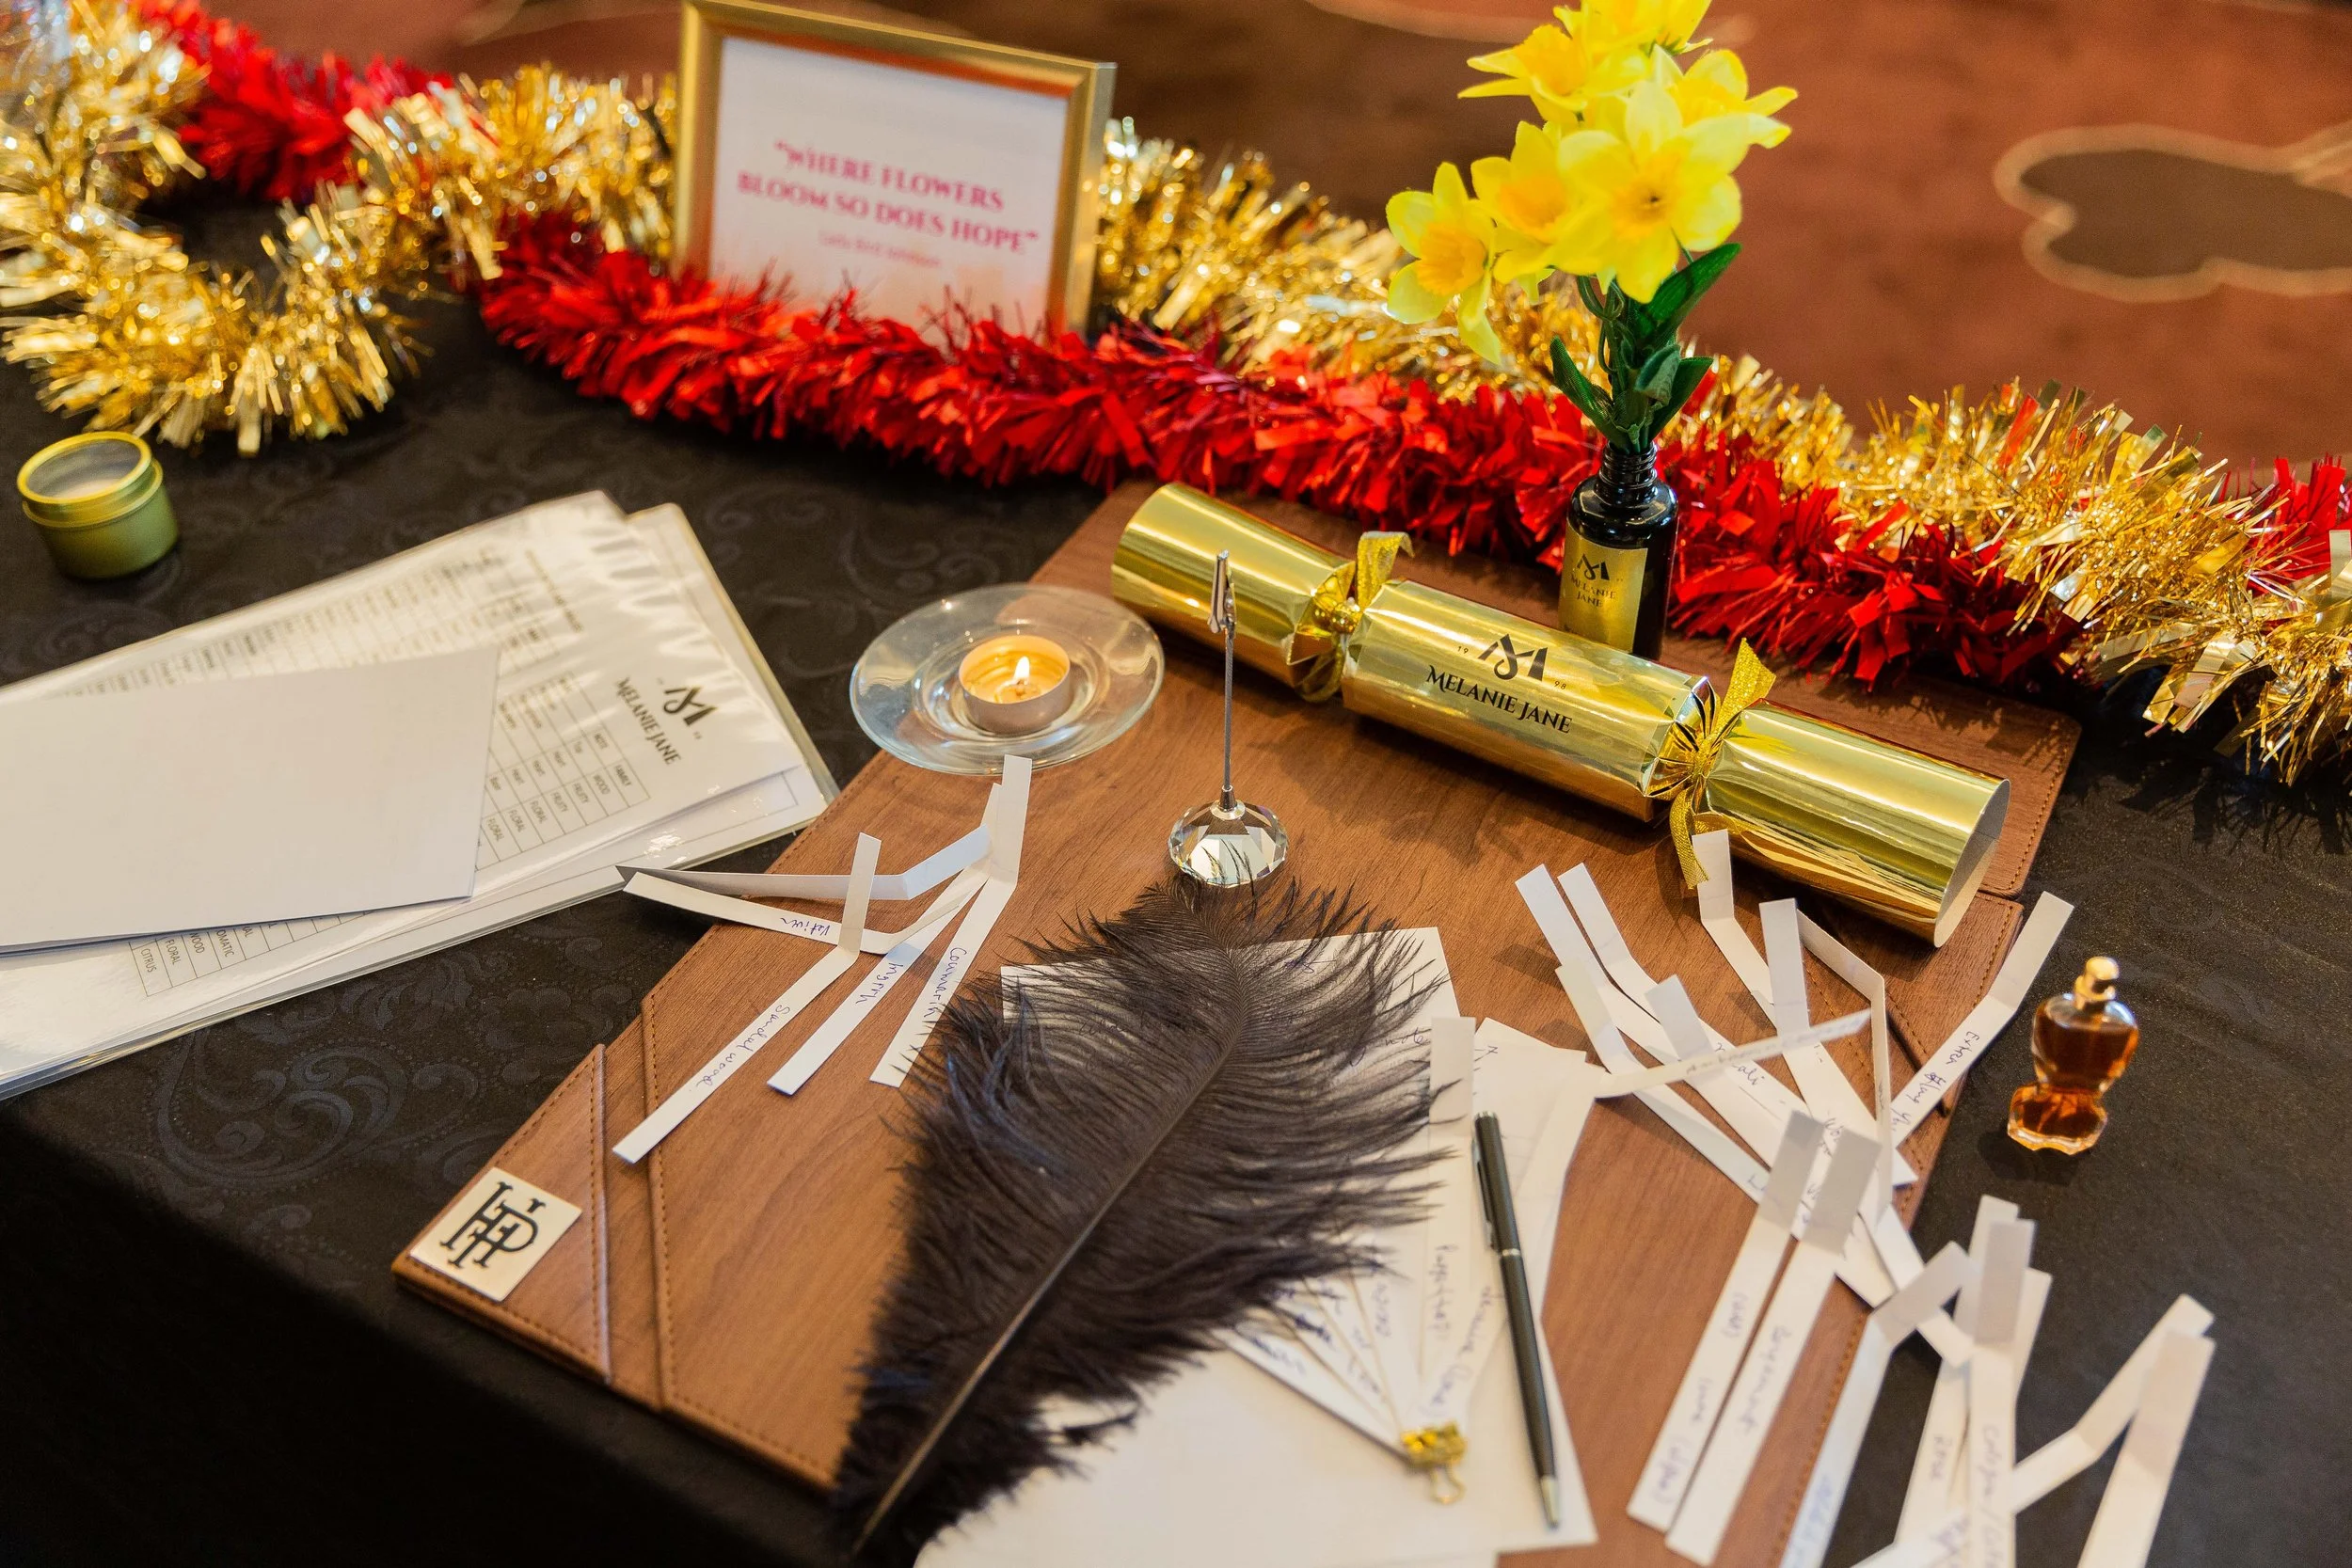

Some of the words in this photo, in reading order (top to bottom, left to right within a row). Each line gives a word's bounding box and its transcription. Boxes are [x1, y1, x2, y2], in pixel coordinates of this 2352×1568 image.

[738, 170, 829, 212] BLOOM
[834, 195, 869, 220] SO
[875, 201, 946, 235] DOES
[882, 165, 1005, 213] FLOWERS
[1570, 573, 1617, 599] MELANIE
[1576, 592, 1604, 608] JANE
[1457, 645, 1470, 656] 19
[1554, 680, 1567, 690] 98
[1426, 664, 1518, 714] MELANIE
[1517, 701, 1573, 734] JANE
[616, 675, 660, 734] MELANIE
[645, 732, 681, 765] JANE
[141, 949, 157, 973] CITRUS
[165, 939, 182, 966] FLORAL
[216, 929, 235, 958] OMATIC
